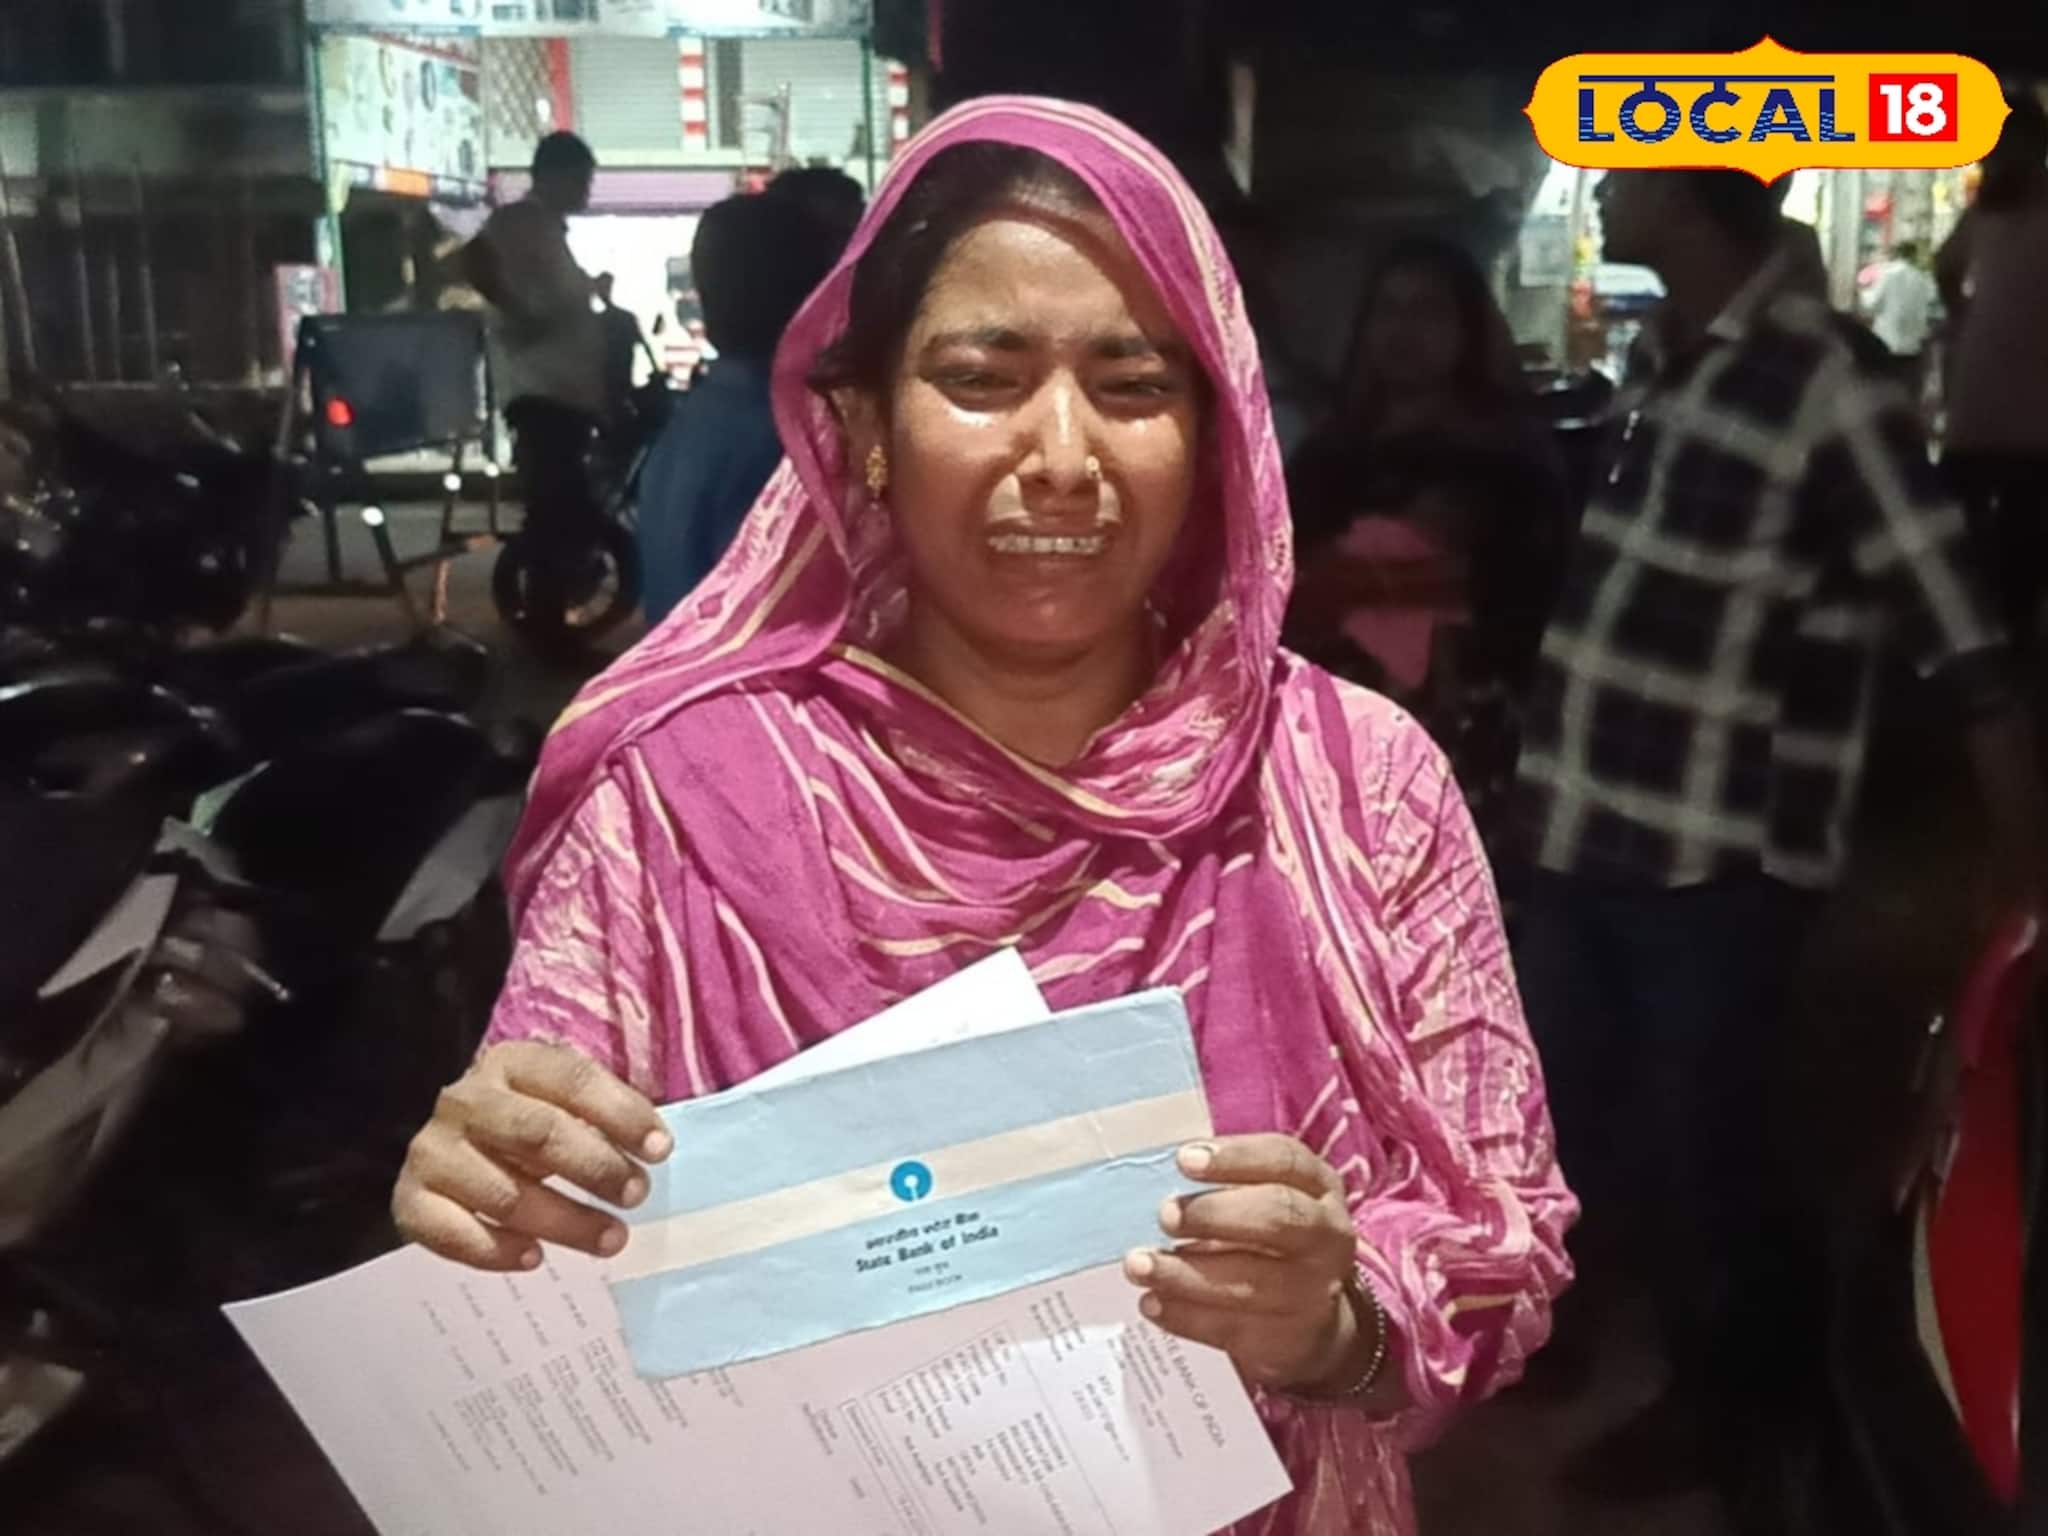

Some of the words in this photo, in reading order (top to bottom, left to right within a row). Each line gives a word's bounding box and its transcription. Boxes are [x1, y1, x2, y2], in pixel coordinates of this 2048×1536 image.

[855, 1254, 892, 1273] State
[897, 1241, 934, 1262] Bank
[940, 1234, 956, 1251] of
[961, 1225, 999, 1244] India
